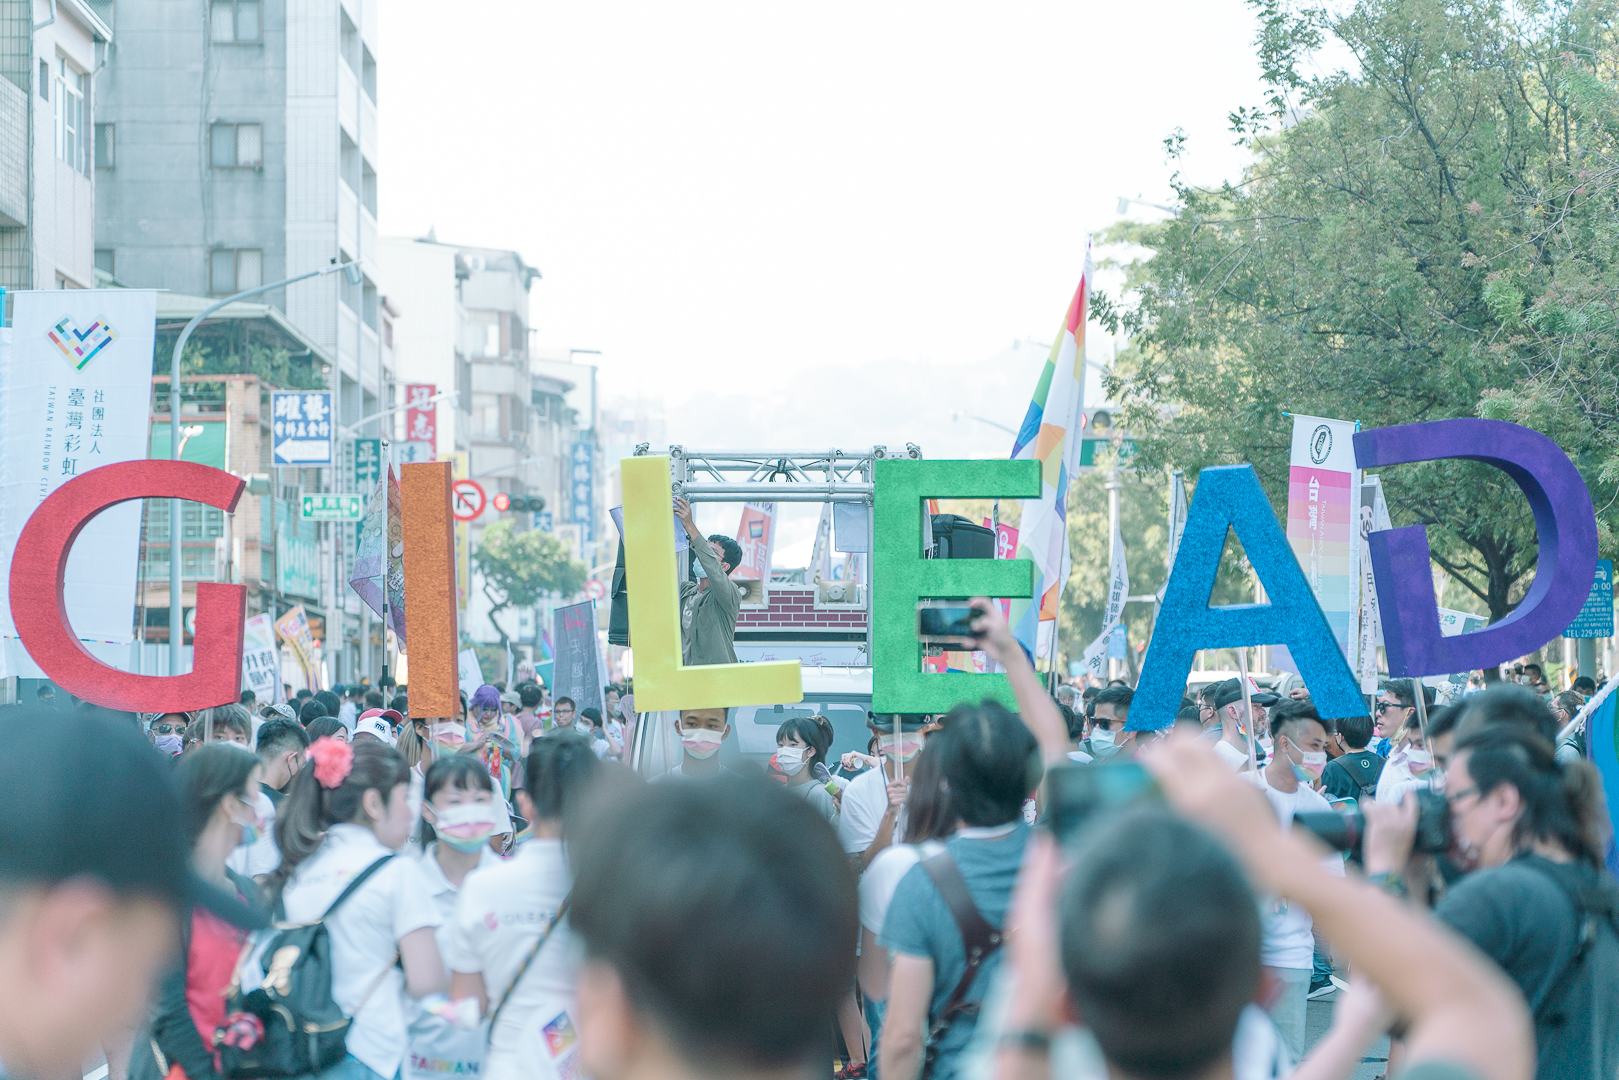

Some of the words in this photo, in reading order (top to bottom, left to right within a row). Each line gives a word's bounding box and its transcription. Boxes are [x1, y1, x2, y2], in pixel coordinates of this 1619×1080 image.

[46, 386, 57, 422] TAIWAN
[89, 389, 105, 454] 社團法人
[42, 427, 53, 472] RAINBOW
[61, 388, 85, 476] 臺灣彩虹
